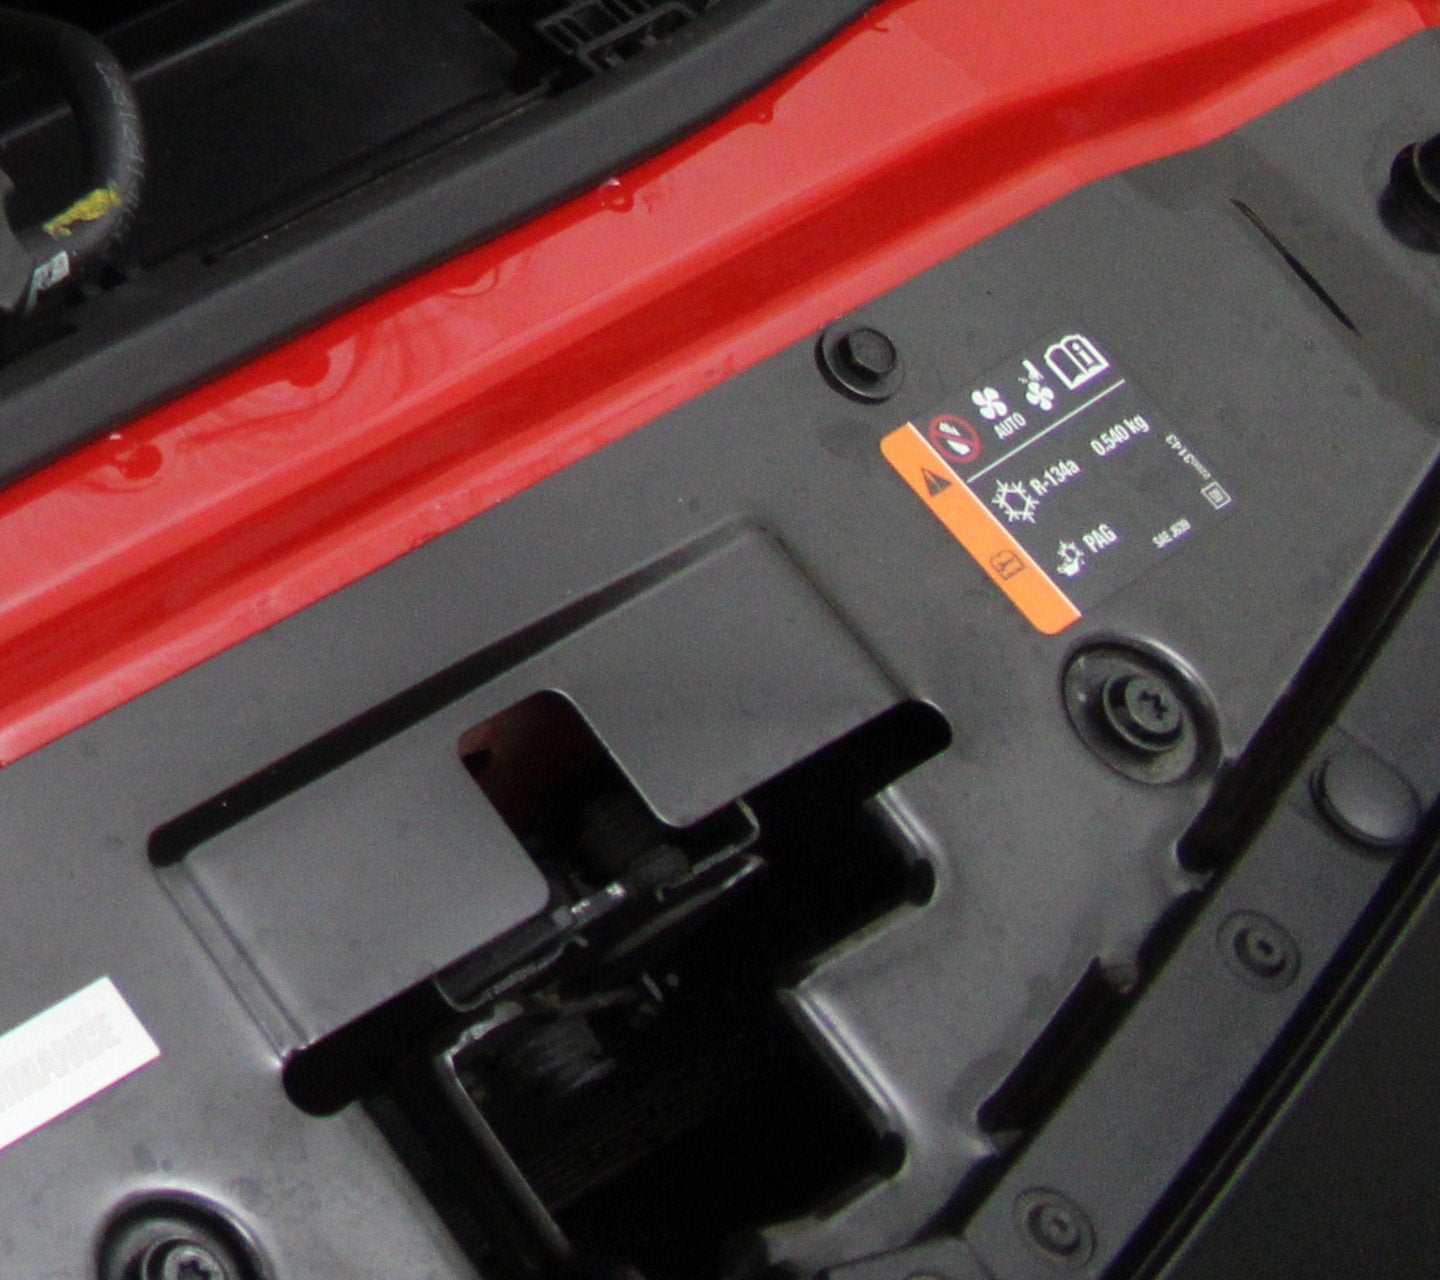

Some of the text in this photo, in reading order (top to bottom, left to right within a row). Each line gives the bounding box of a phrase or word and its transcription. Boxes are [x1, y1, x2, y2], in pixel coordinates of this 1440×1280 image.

[993, 412, 1026, 440] AUTO
[1030, 414, 1151, 496] R-134a 0.540 kg
[1082, 523, 1118, 554] PAG
